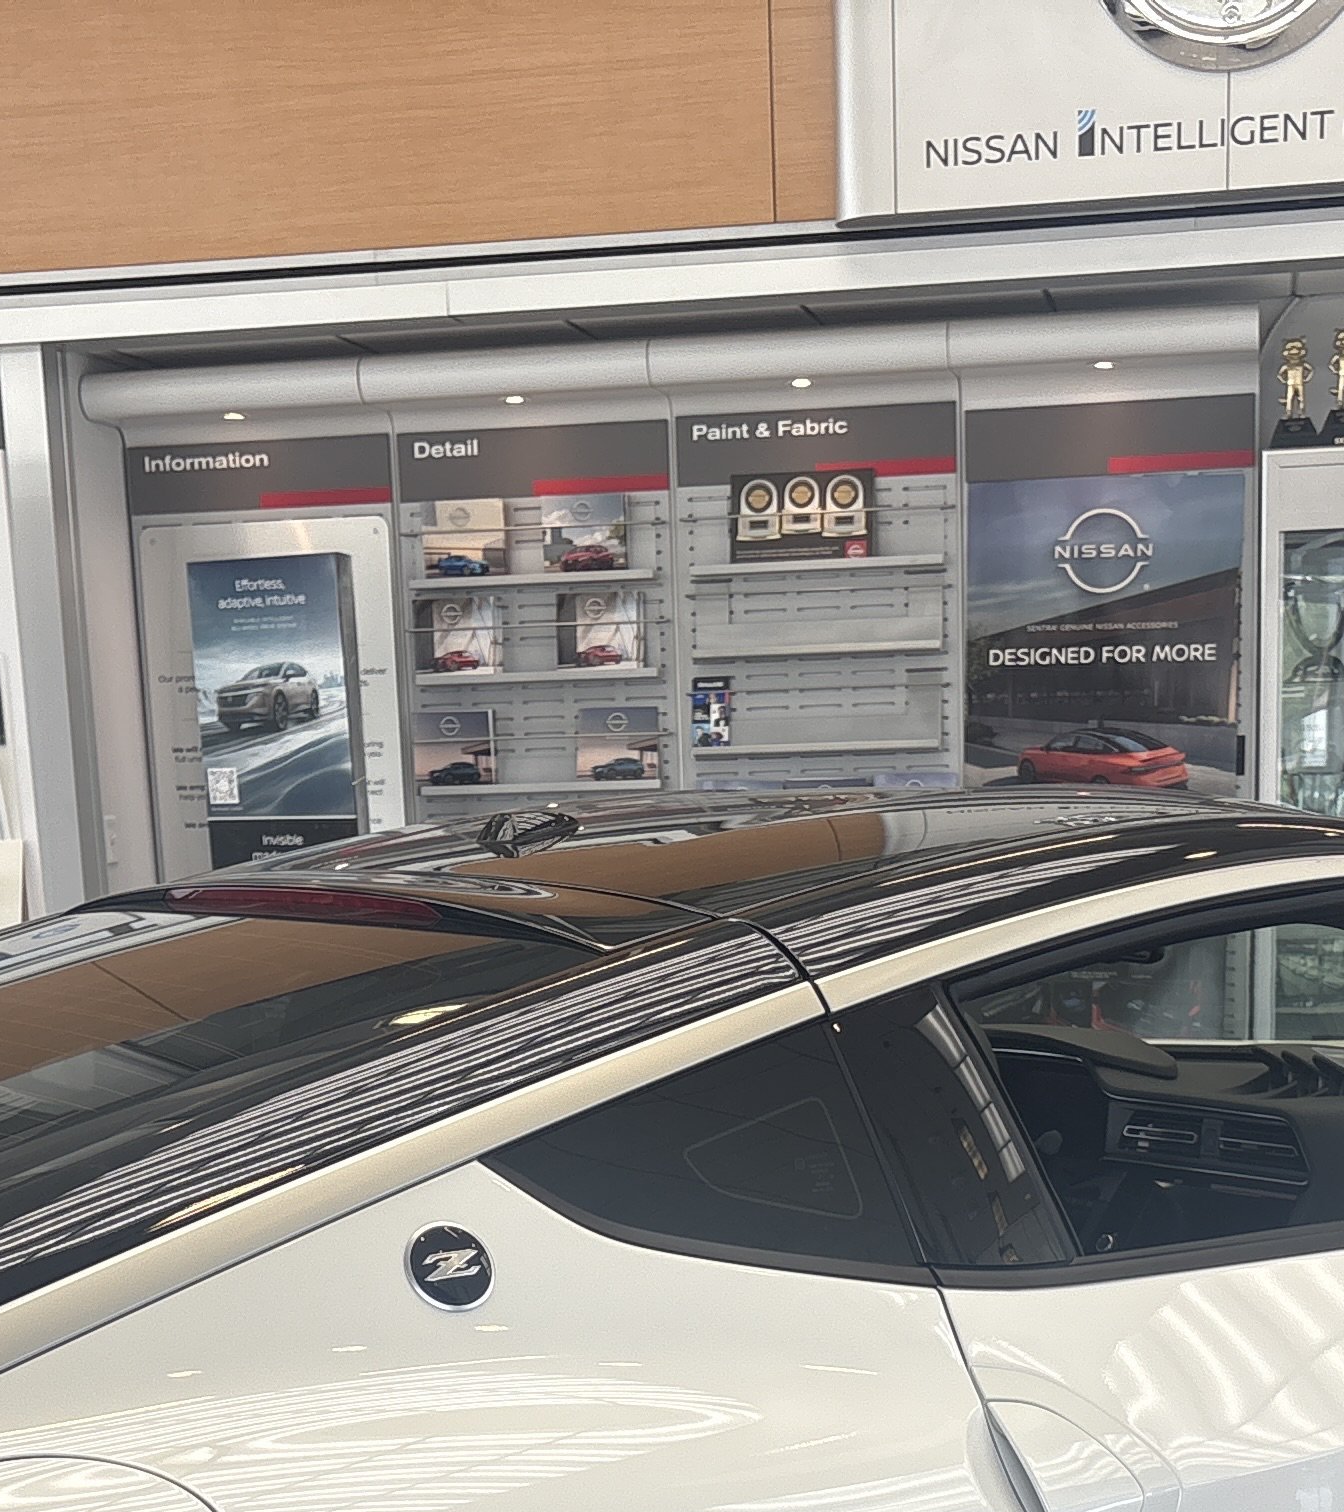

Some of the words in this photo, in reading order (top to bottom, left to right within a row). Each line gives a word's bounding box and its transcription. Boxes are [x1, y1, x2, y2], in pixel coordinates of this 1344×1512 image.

[925, 130, 1058, 168] NISSAN
[1077, 109, 1336, 157] INTELLIGENT
[691, 422, 751, 441] Paint
[755, 422, 771, 438] &
[777, 418, 849, 437] Fabric
[413, 439, 479, 459] Detail
[143, 451, 270, 473] Information
[1053, 542, 1154, 560] NISSAN
[988, 646, 1096, 667] DESIGNED
[1101, 645, 1146, 664] FOR
[1152, 643, 1218, 662] MORE
[261, 834, 305, 847] Invisible
